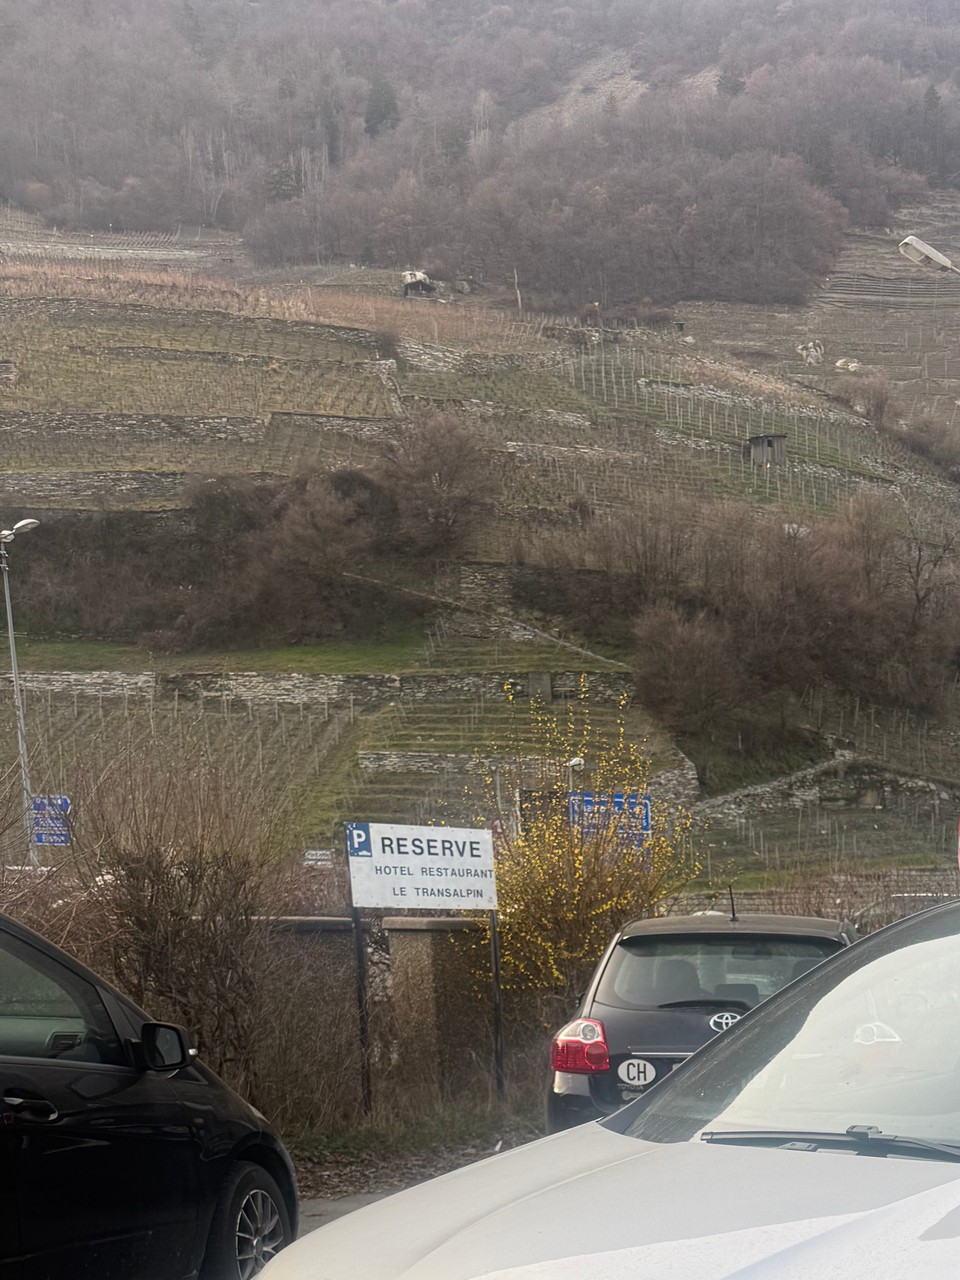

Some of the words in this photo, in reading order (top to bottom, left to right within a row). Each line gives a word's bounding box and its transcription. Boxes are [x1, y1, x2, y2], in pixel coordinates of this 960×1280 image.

[353, 830, 366, 848] P
[381, 837, 482, 858] RESERVE
[375, 865, 414, 876] HOTEL
[421, 867, 494, 879] RESTAURANT
[393, 887, 407, 896] LE
[414, 888, 484, 898] TRANSALPIN
[626, 1062, 647, 1082] CH
